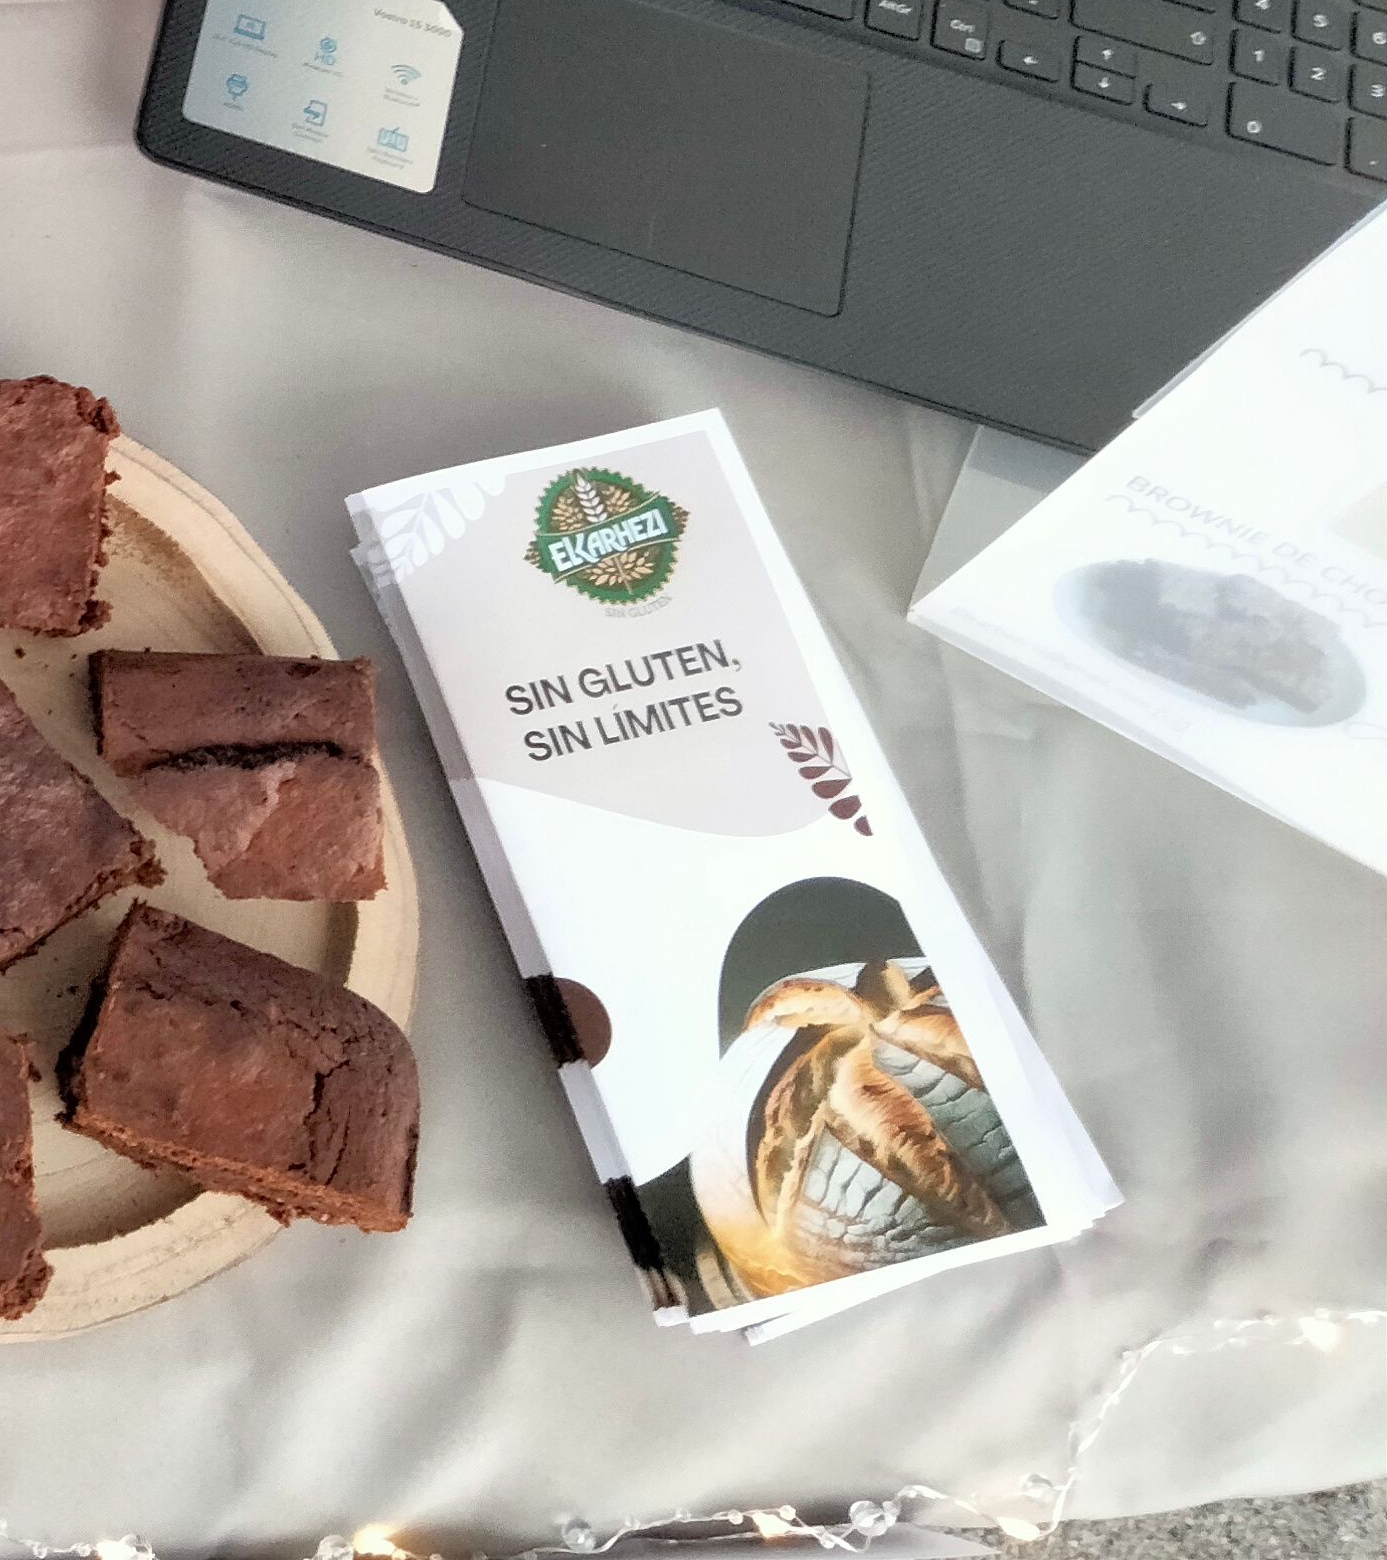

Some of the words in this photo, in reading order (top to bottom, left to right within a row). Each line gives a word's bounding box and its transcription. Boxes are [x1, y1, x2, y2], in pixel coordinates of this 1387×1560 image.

[1126, 474, 1268, 545] BROWNIE
[505, 674, 573, 716] SIN
[577, 638, 742, 699] GLUTEN,
[523, 720, 593, 762] SIN
[593, 685, 744, 746] LÍMITES
